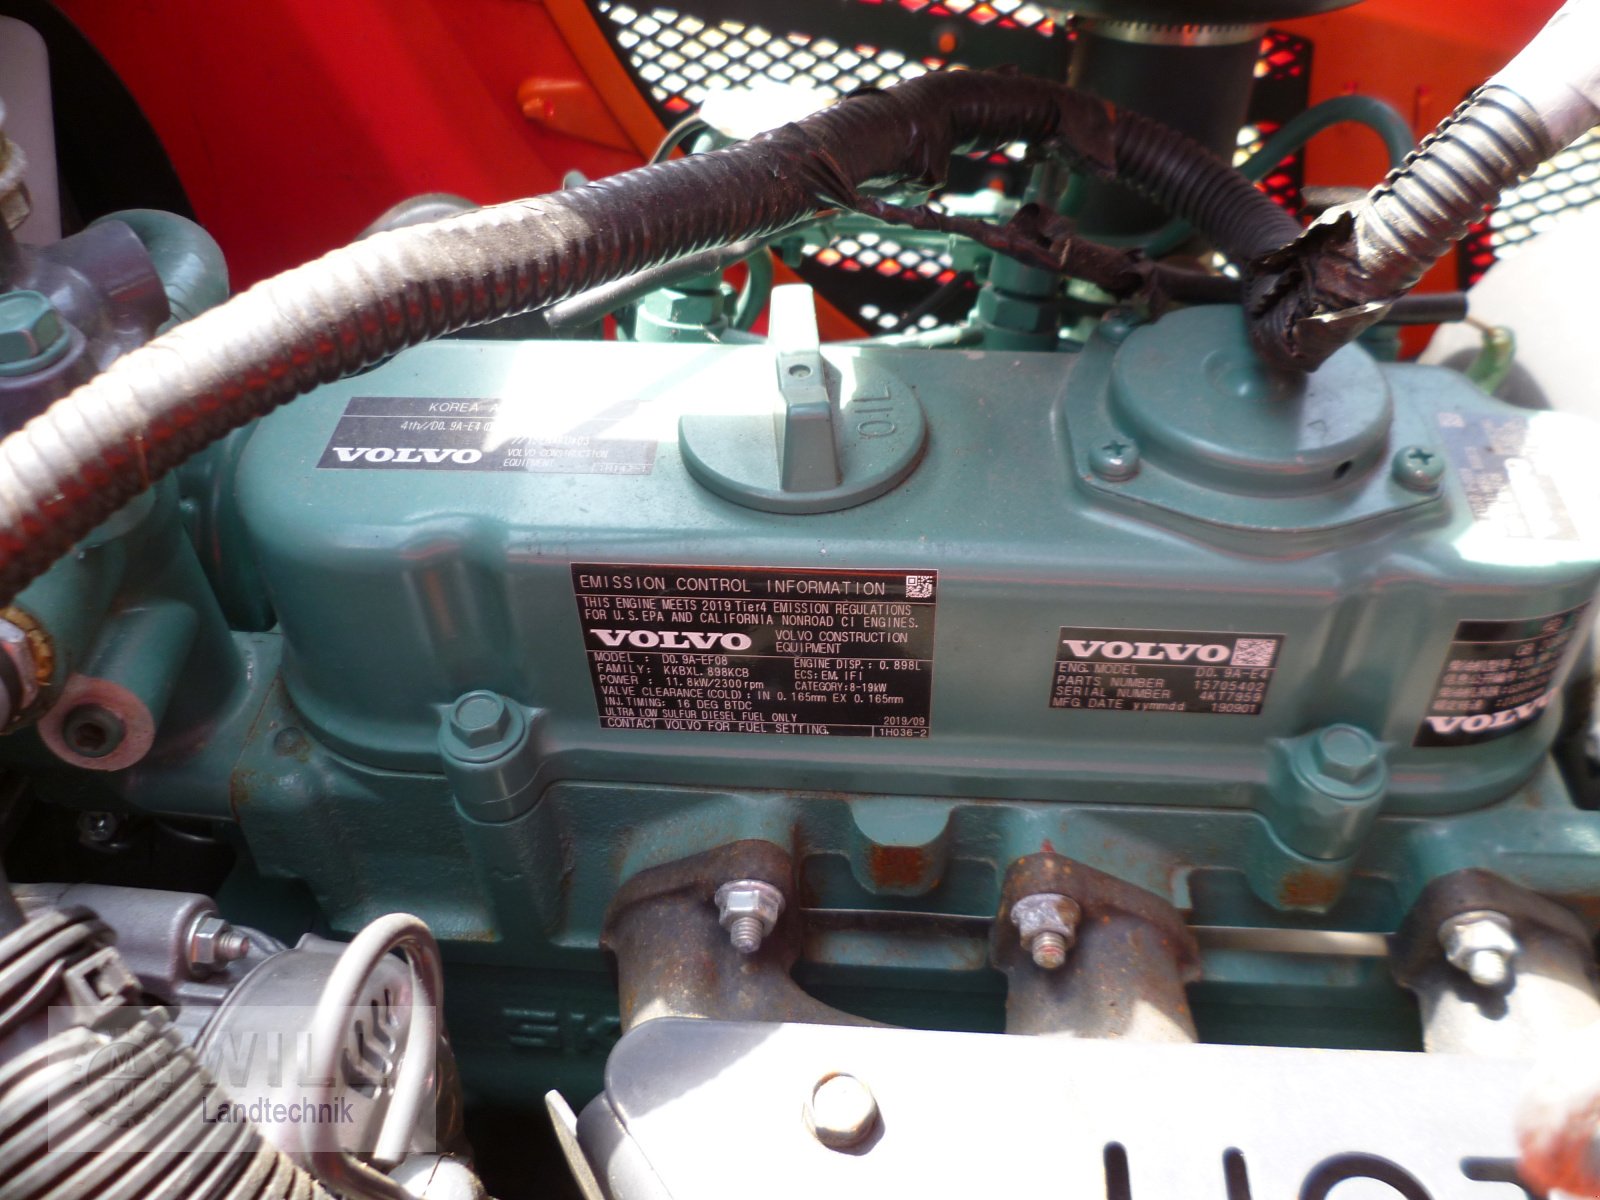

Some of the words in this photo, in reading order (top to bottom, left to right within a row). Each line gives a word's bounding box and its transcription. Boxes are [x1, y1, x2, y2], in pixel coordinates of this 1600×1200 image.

[429, 402, 479, 412] KOREA
[852, 383, 897, 439] OIL
[332, 447, 482, 464] VOLVO
[507, 449, 536, 457] VOLVO
[540, 449, 609, 458] CONSTRUCTION
[503, 458, 555, 467] EQUIPMENT
[579, 575, 665, 590] EMISSION
[676, 577, 751, 593] CONTROL
[767, 580, 886, 596] INFORMATION
[583, 596, 610, 608] THIS
[616, 597, 657, 610] ENGINE
[662, 599, 697, 611] MEETS
[702, 600, 732, 612] 2019
[735, 601, 767, 613] Tier4
[773, 602, 829, 614] EMISSION
[835, 604, 912, 616] REGULATIONS
[585, 609, 607, 620] FOR
[671, 612, 693, 623] AND
[700, 612, 774, 625] CALIFORNIA
[782, 615, 834, 627] NONROAD
[841, 616, 855, 628] CI
[864, 617, 919, 629] ENGINES.
[590, 628, 752, 651] VOLVO
[775, 630, 813, 642] VOLVO
[819, 631, 909, 643] CONSTRUCTION
[776, 642, 842, 654] EQUIPMENT
[1062, 639, 1231, 662] VOLVO
[594, 652, 635, 663] MODEL
[794, 658, 831, 669] ENGINE
[1094, 664, 1138, 675] MODEL
[599, 674, 639, 686] POWER
[1057, 675, 1102, 686] PARTS
[1110, 678, 1165, 689] NUMBER
[601, 686, 636, 696] VALVE
[758, 692, 770, 701] IN
[833, 693, 847, 703] EX
[1056, 686, 1107, 697] SERIAL
[1116, 688, 1171, 699] NUMBER
[678, 700, 690, 709] 16
[697, 700, 718, 710] DEG
[724, 701, 752, 711] BTDC
[1052, 697, 1081, 708] MFG
[1088, 698, 1123, 709] DATE
[605, 708, 634, 718] ULTRA
[639, 709, 658, 718] LOW
[662, 710, 697, 719] SULFUR
[702, 711, 737, 721] DIESEL
[742, 712, 766, 722] FUEL
[772, 713, 798, 723] ONLY
[884, 716, 926, 726] 2019/09
[607, 718, 657, 729] CONTACT
[665, 720, 702, 731] VOLVO
[708, 721, 730, 732] FOR
[738, 722, 767, 733] FUEL
